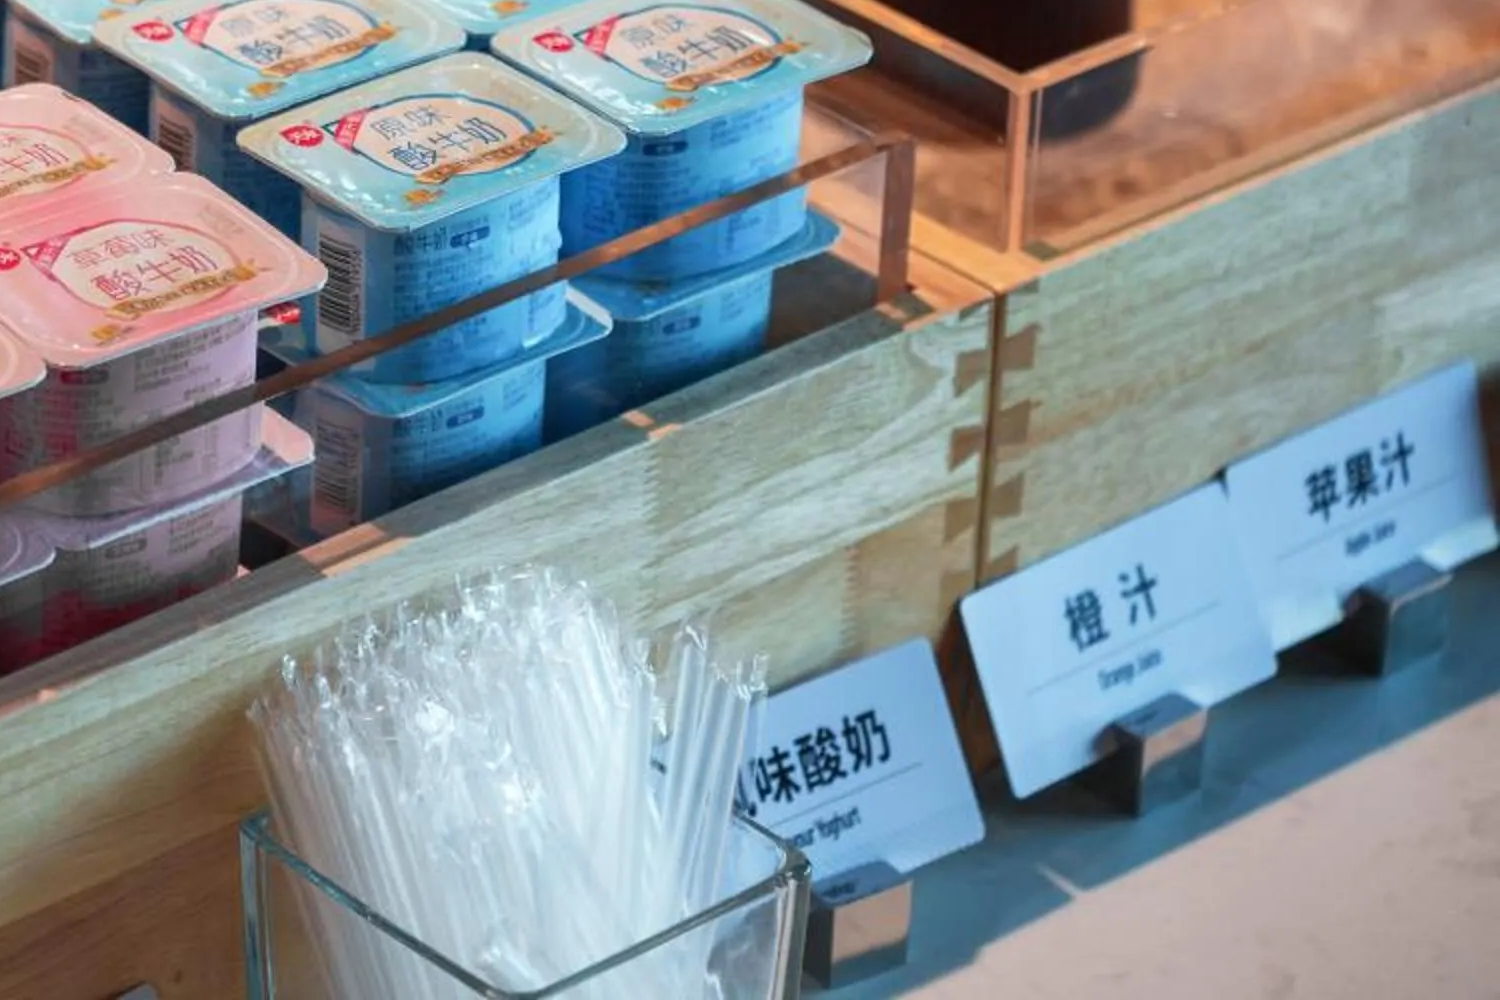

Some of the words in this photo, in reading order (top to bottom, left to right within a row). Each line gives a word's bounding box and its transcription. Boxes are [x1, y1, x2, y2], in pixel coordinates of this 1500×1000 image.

[639, 25, 752, 78] 酸牛奶
[368, 104, 451, 141] 原味
[387, 116, 508, 170] 酸牛奶
[66, 228, 175, 271] 草莓味
[90, 244, 218, 301] 酸牛奶
[1305, 426, 1415, 523] 苹果汁
[1064, 563, 1157, 652] 橙汁
